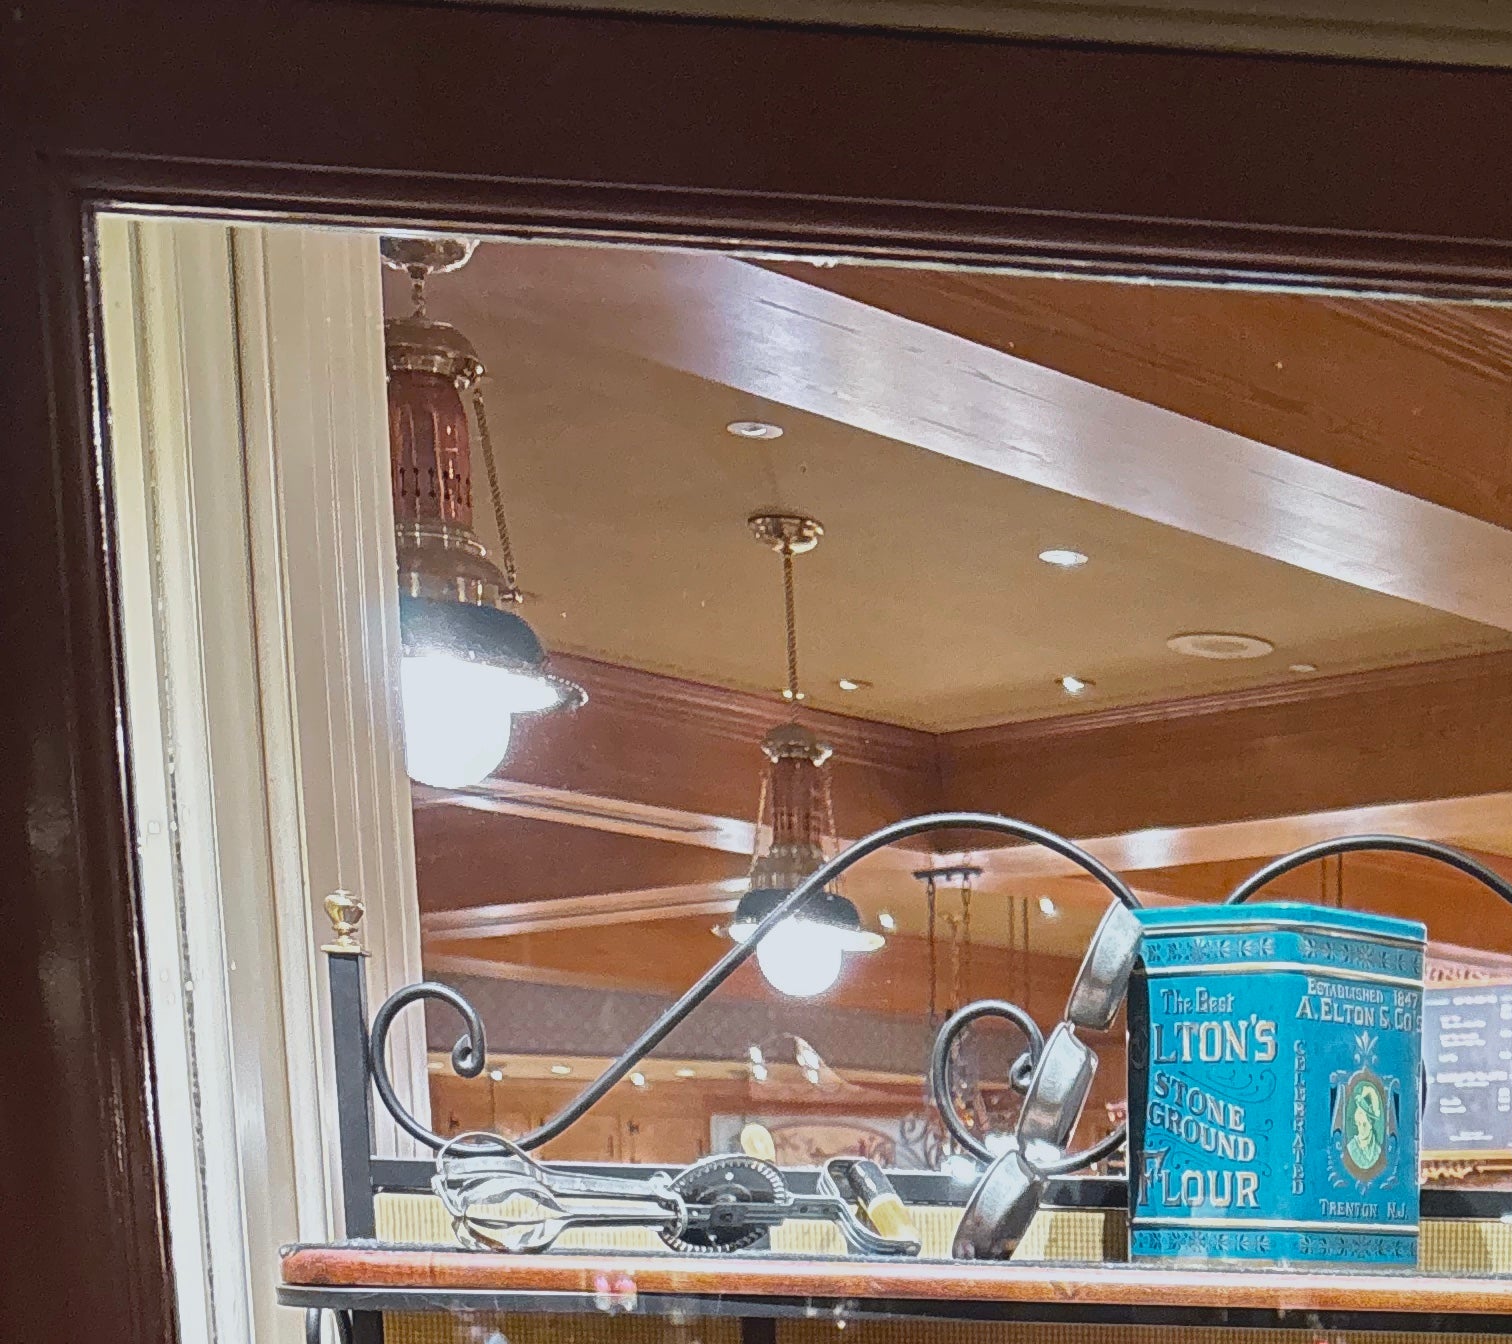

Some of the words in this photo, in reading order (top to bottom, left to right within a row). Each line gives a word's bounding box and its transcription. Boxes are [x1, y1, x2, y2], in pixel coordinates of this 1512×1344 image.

[1160, 988, 1193, 1015] The
[1307, 978, 1383, 1004] ESTABLISHED
[1393, 989, 1418, 1009] 1847
[1154, 1070, 1245, 1132] STONE
[1148, 1100, 1256, 1163] GROUND
[1137, 1147, 1260, 1209] FLOUR
[1319, 1198, 1378, 1218] TRENTON
